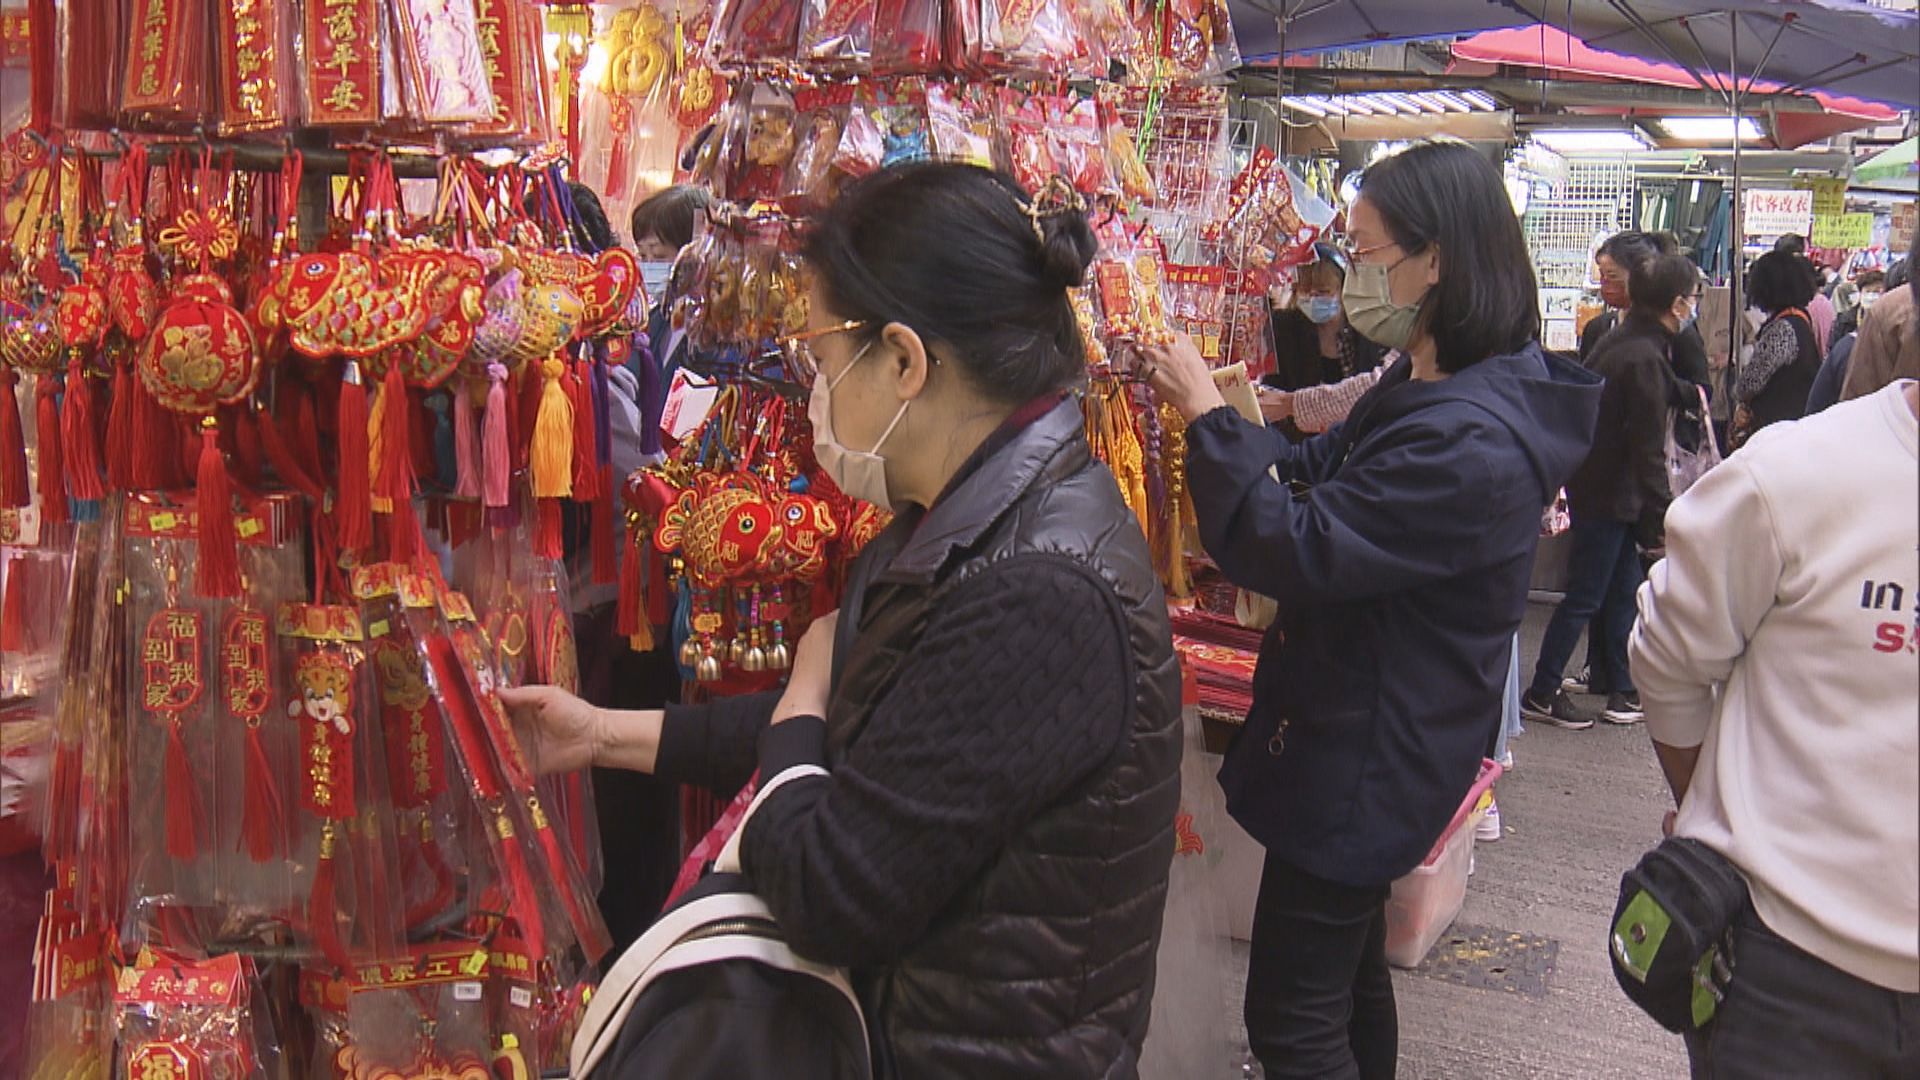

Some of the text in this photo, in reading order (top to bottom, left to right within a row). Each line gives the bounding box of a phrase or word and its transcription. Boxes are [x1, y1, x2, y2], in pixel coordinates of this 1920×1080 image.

[322, 0, 363, 112] 落平安
[1751, 193, 1809, 213] 代客改衣
